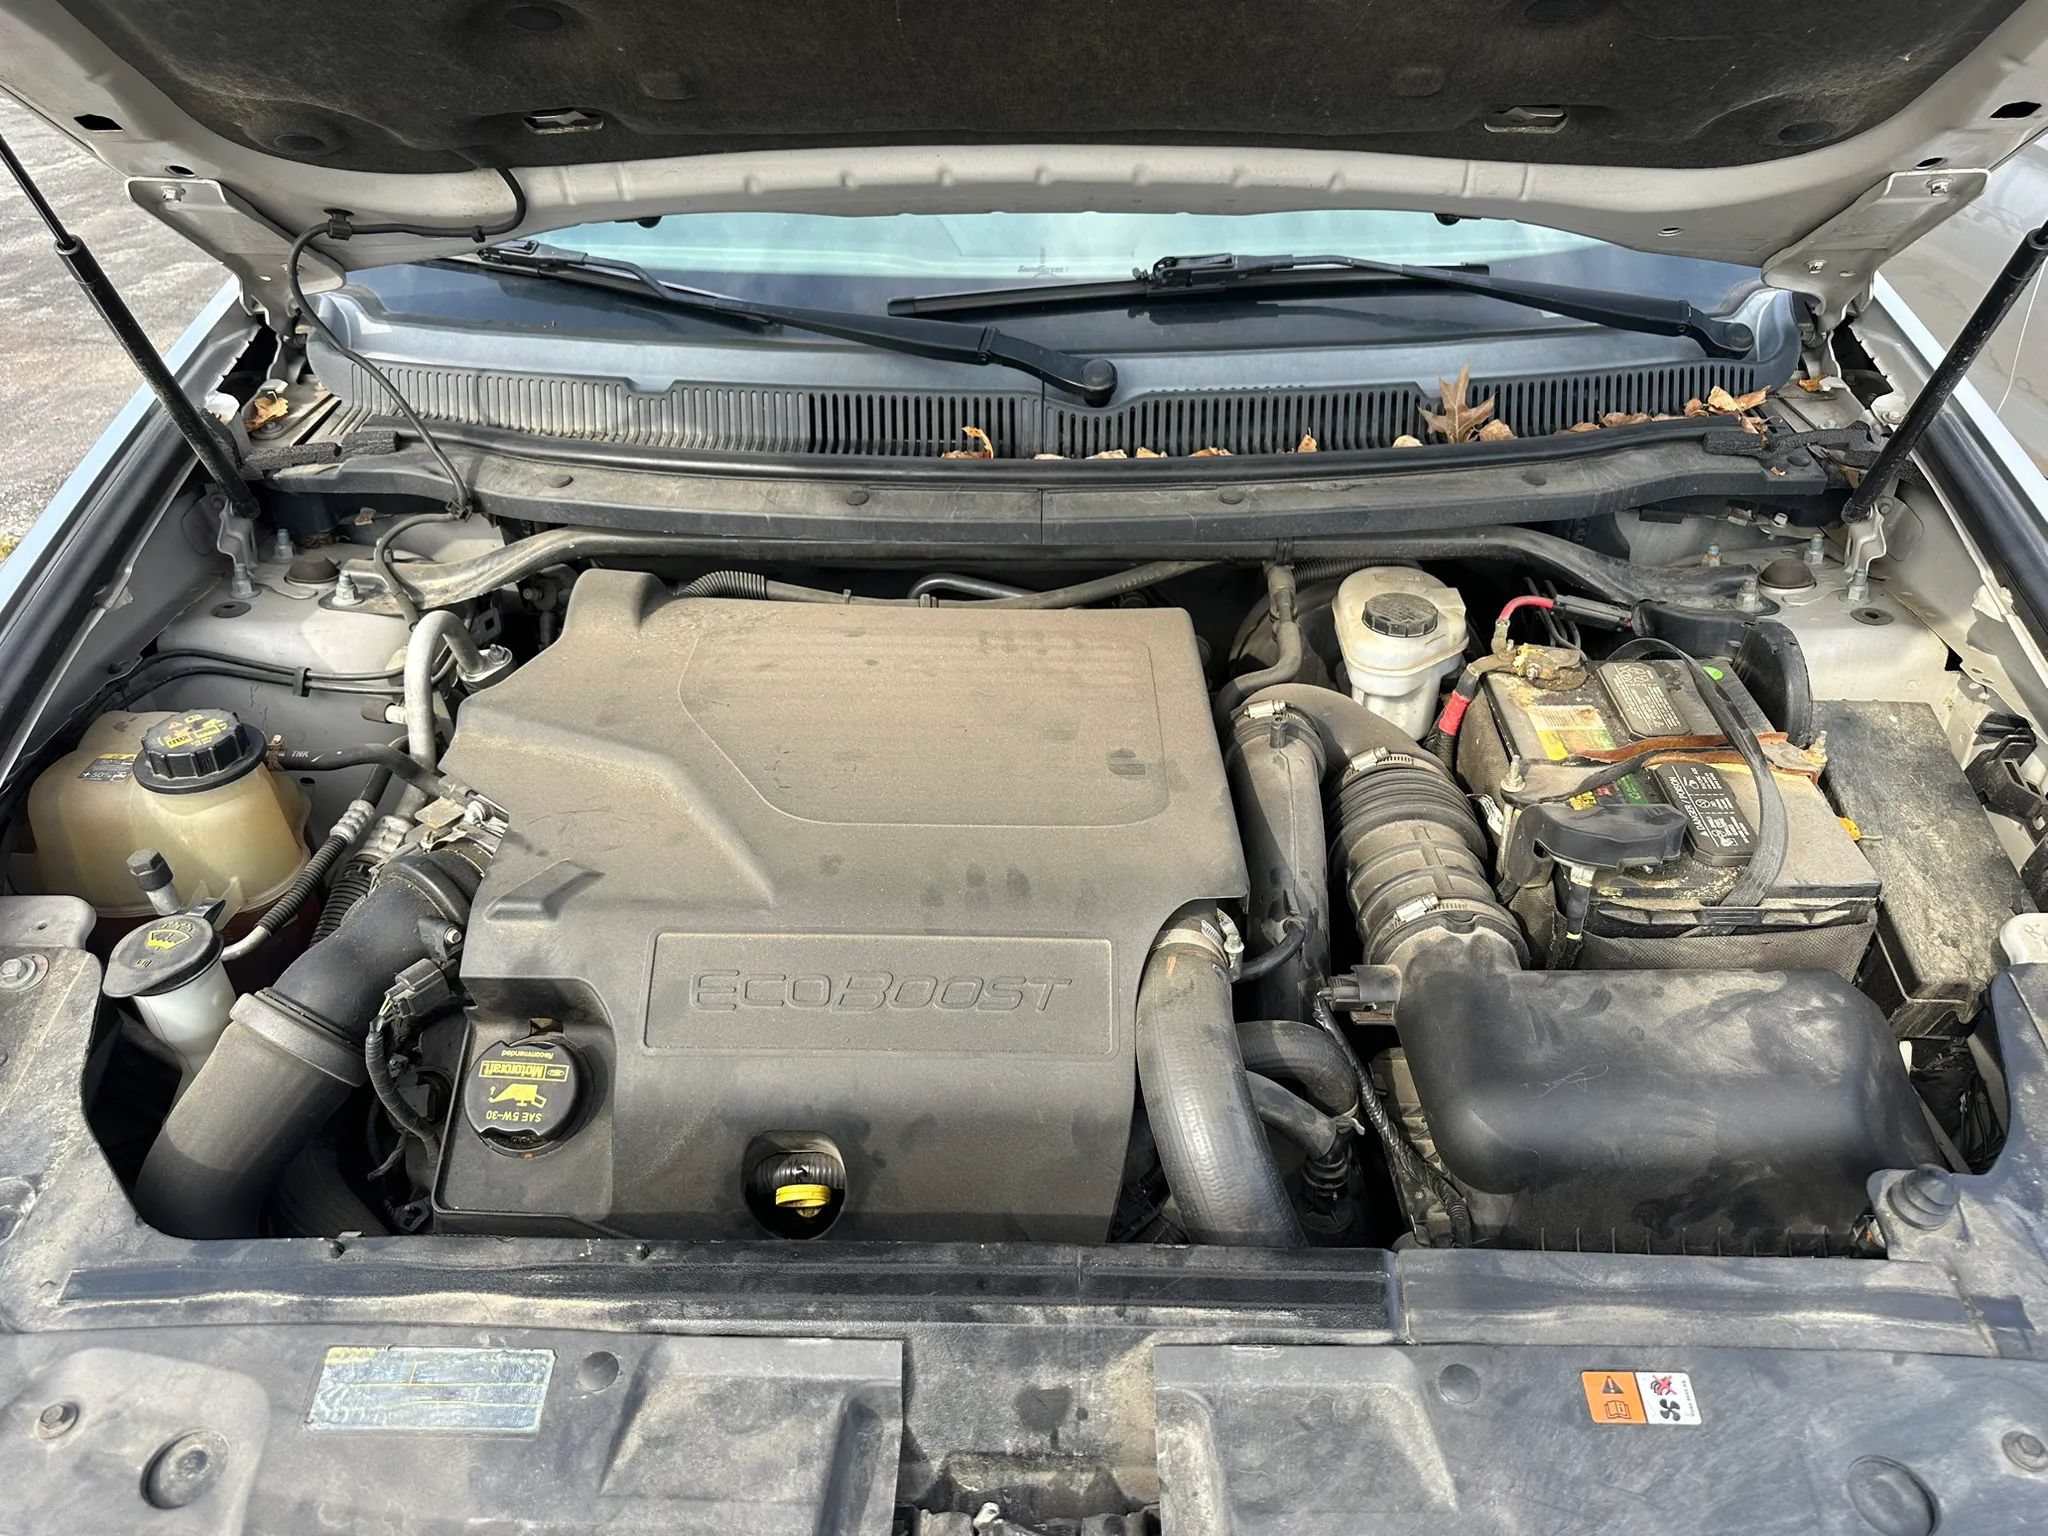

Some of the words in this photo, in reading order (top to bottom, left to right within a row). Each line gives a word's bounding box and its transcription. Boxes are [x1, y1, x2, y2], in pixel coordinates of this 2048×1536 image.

[1667, 776, 1687, 798] POISON
[1684, 804, 1705, 830] DANGER
[483, 1063, 545, 1078] Motorcraft
[485, 1110, 519, 1122] 5W-30
[520, 1112, 542, 1123] SAE
